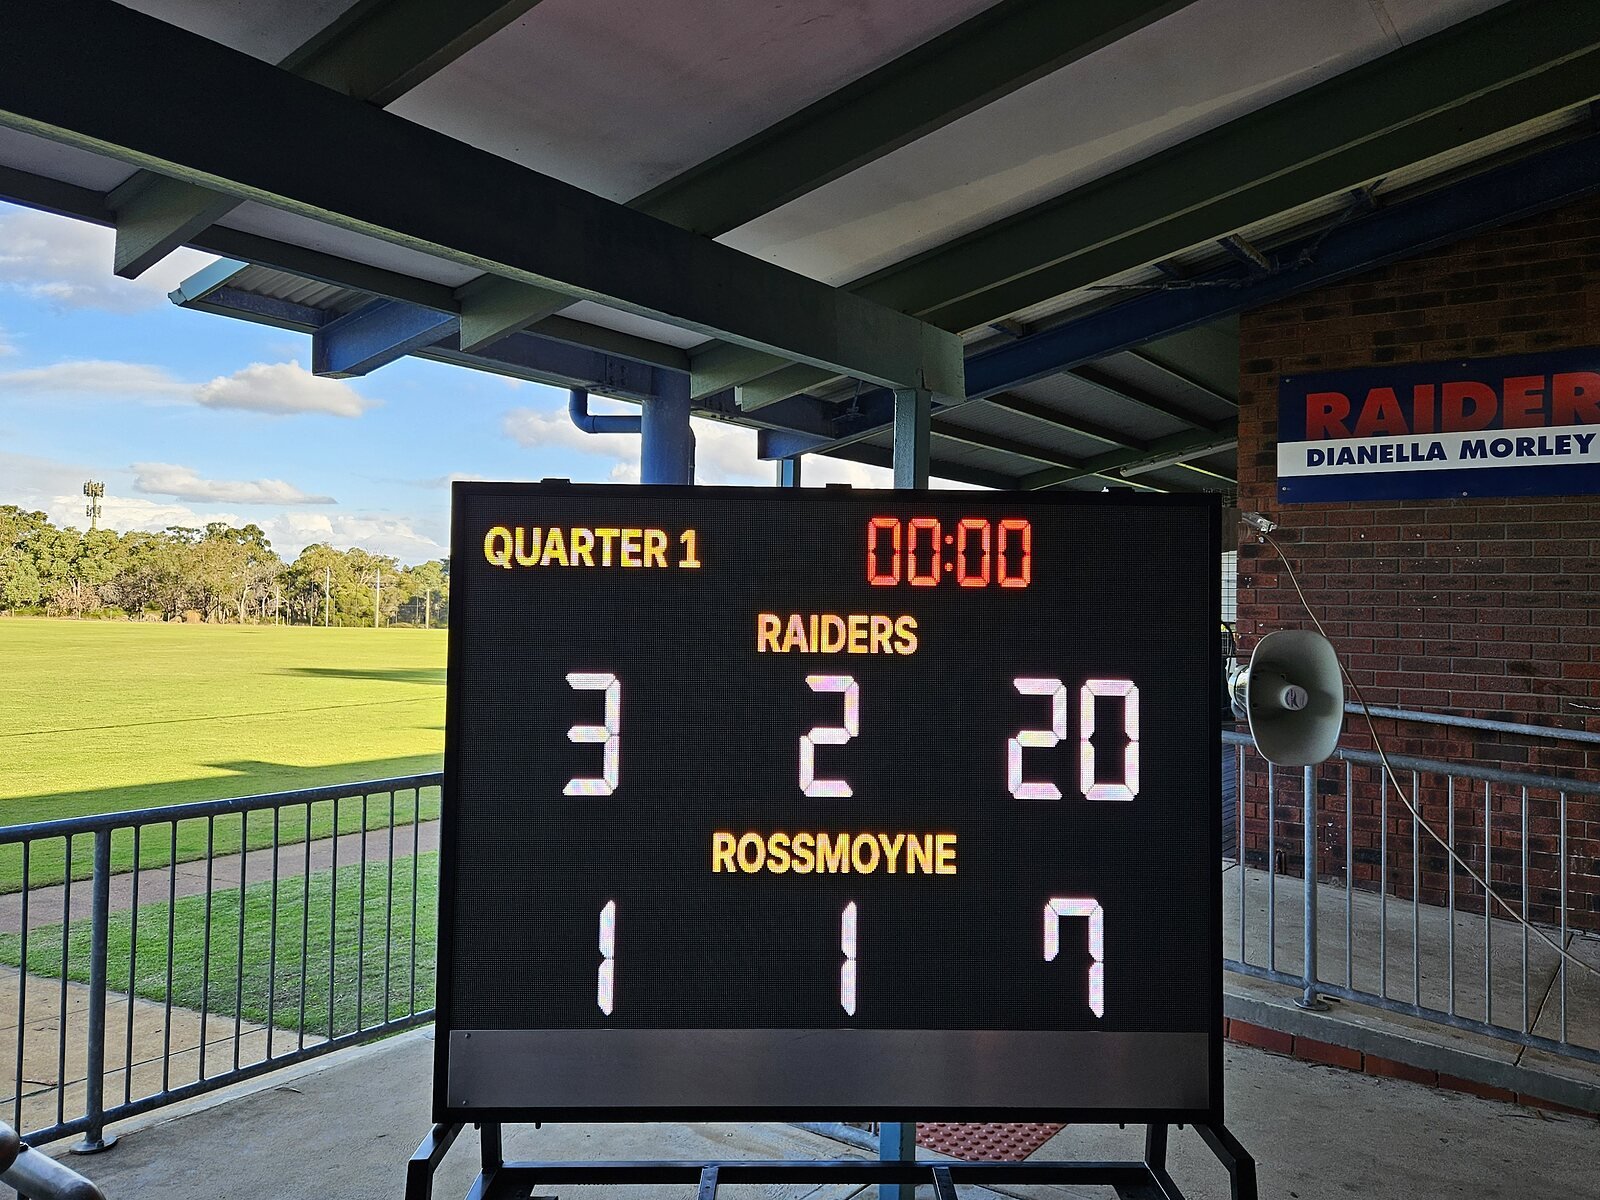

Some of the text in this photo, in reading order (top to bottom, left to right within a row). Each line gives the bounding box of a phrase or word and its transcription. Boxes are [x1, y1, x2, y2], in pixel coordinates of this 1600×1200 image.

[1307, 433, 1597, 467] DIANELLA MORLEY
[484, 526, 701, 569] QUARTER 1
[867, 517, 1032, 588] 00:00
[757, 613, 918, 656] RAIDERS
[563, 673, 1139, 801] 3 2 20
[712, 831, 957, 875] ROSSMOYNE
[597, 898, 1105, 1018] 1 1 7
